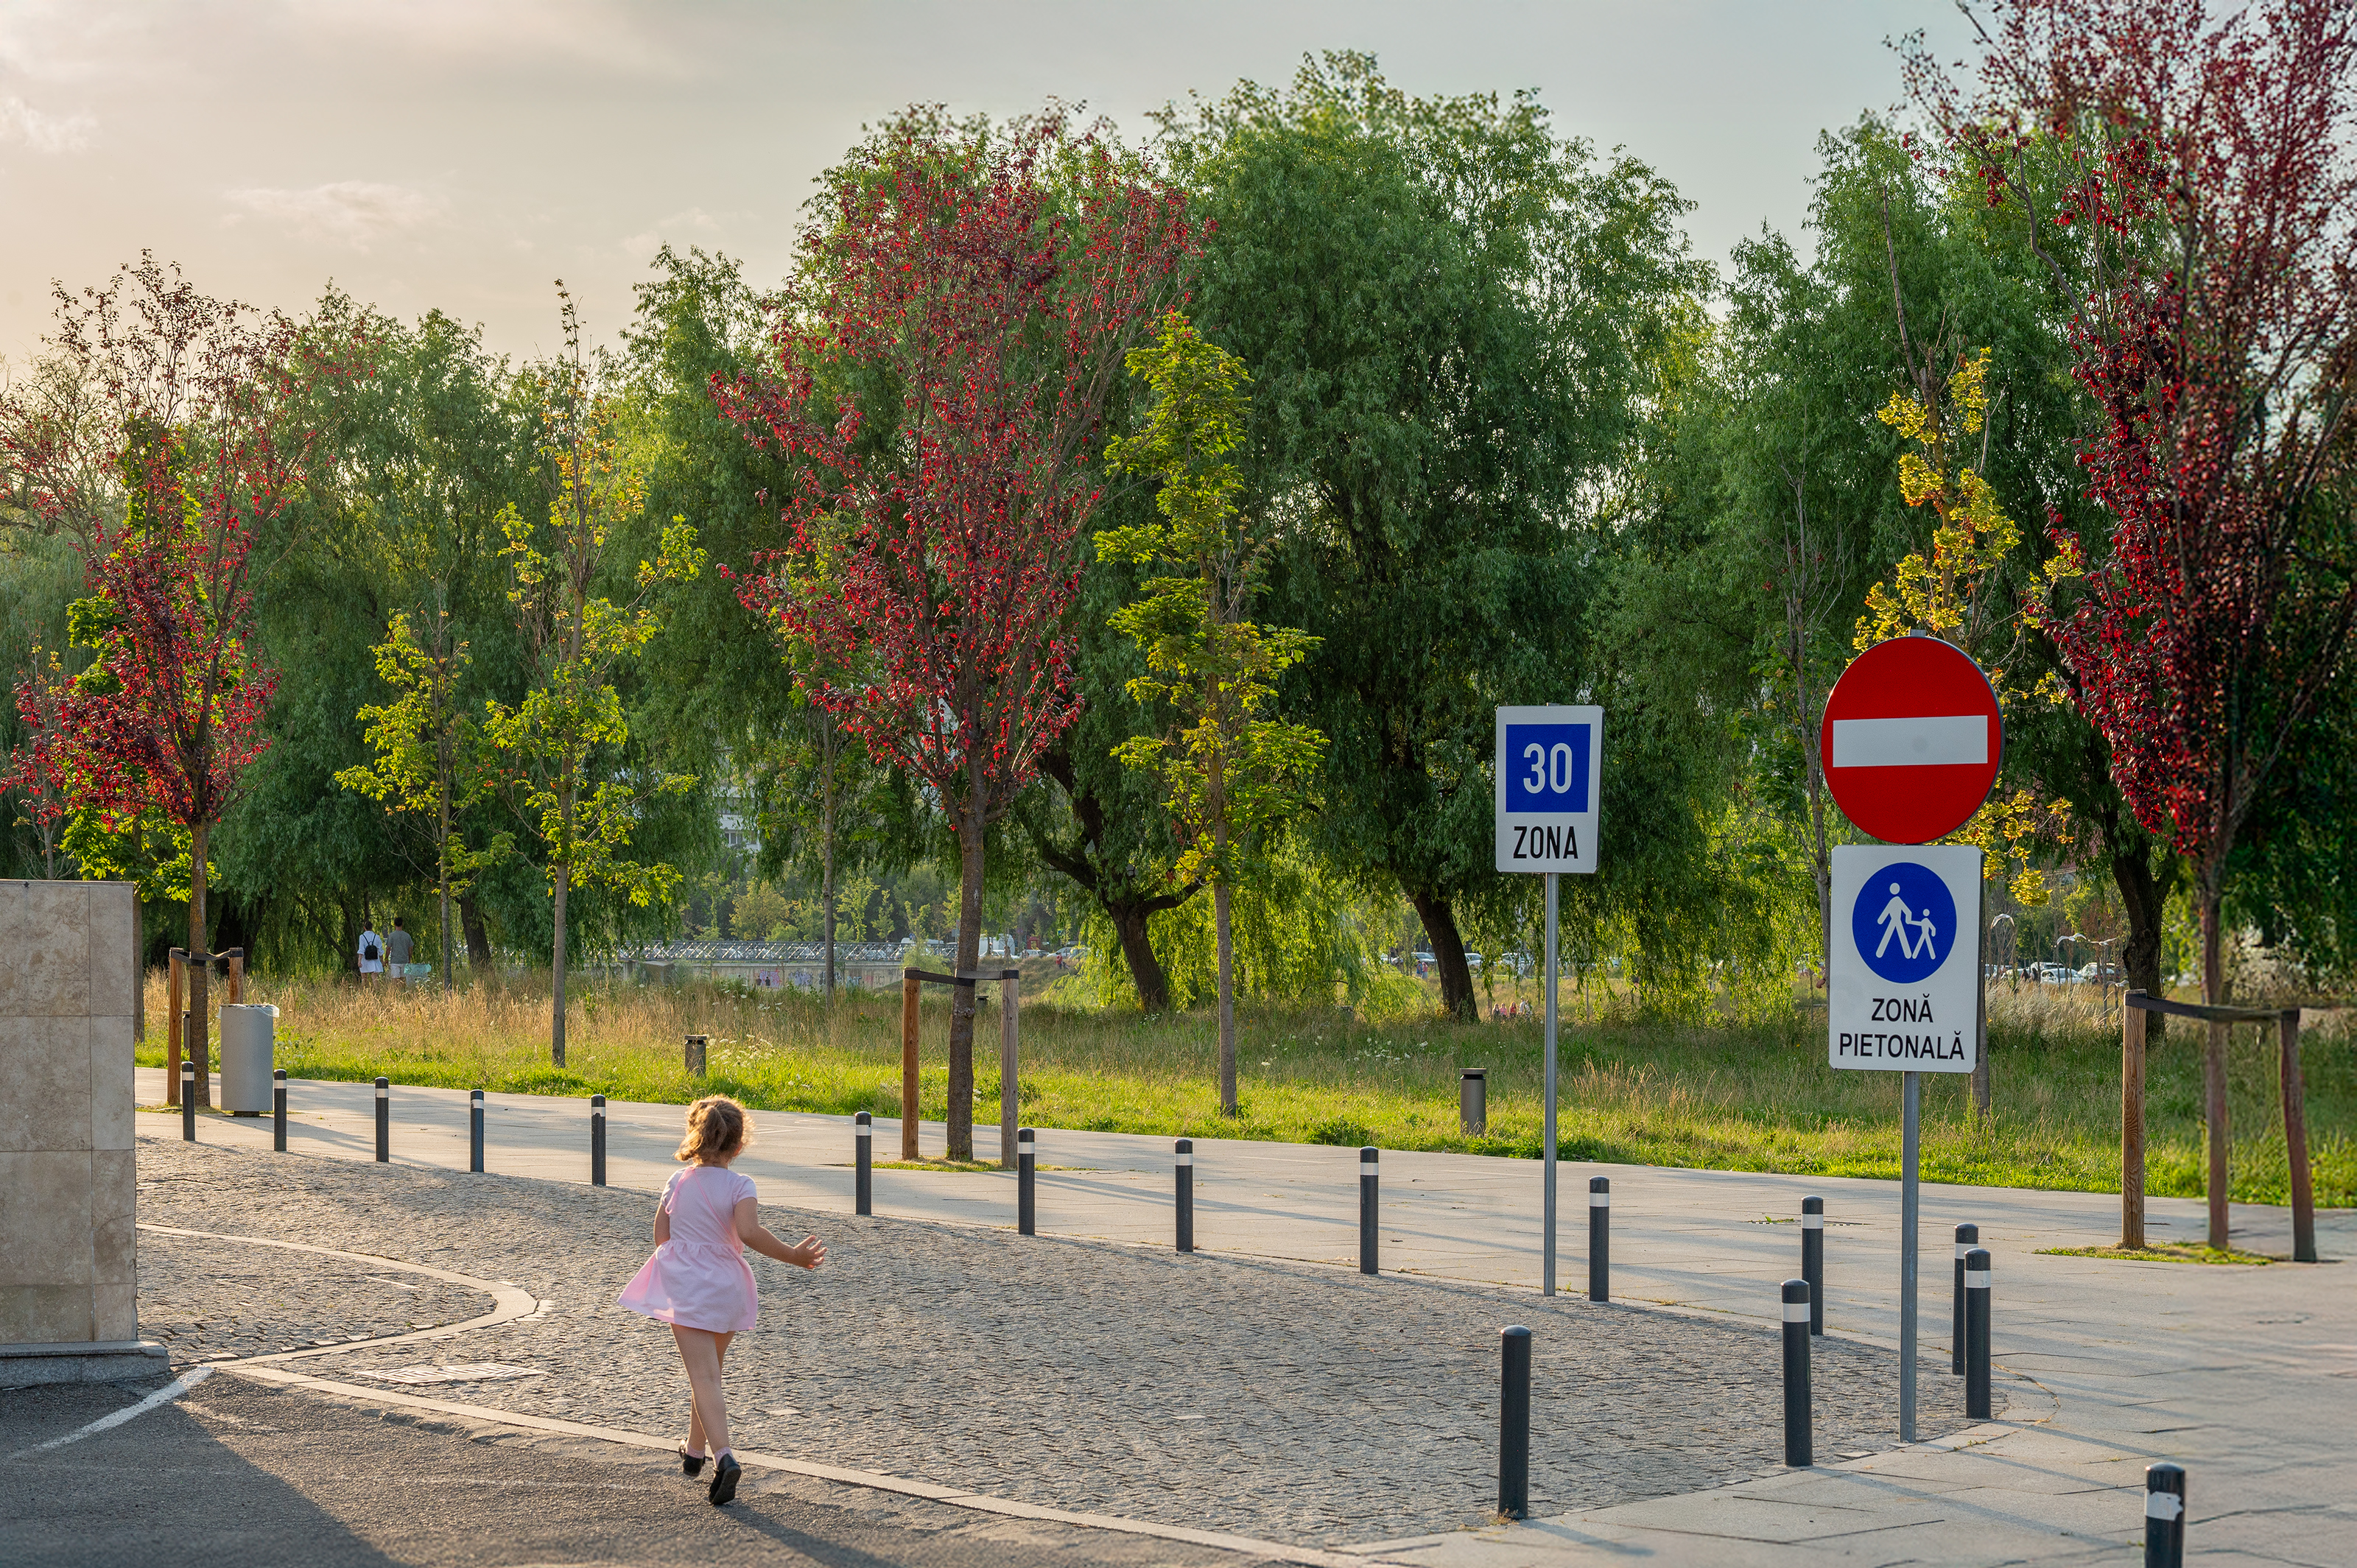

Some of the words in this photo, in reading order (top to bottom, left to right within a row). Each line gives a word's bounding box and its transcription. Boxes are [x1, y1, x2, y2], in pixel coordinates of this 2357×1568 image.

[1523, 742, 1573, 794] 30
[1513, 826, 1579, 859] ZONA
[1872, 993, 1934, 1023] ZONĂ
[1840, 1030, 1965, 1061] PIETONALĂ
